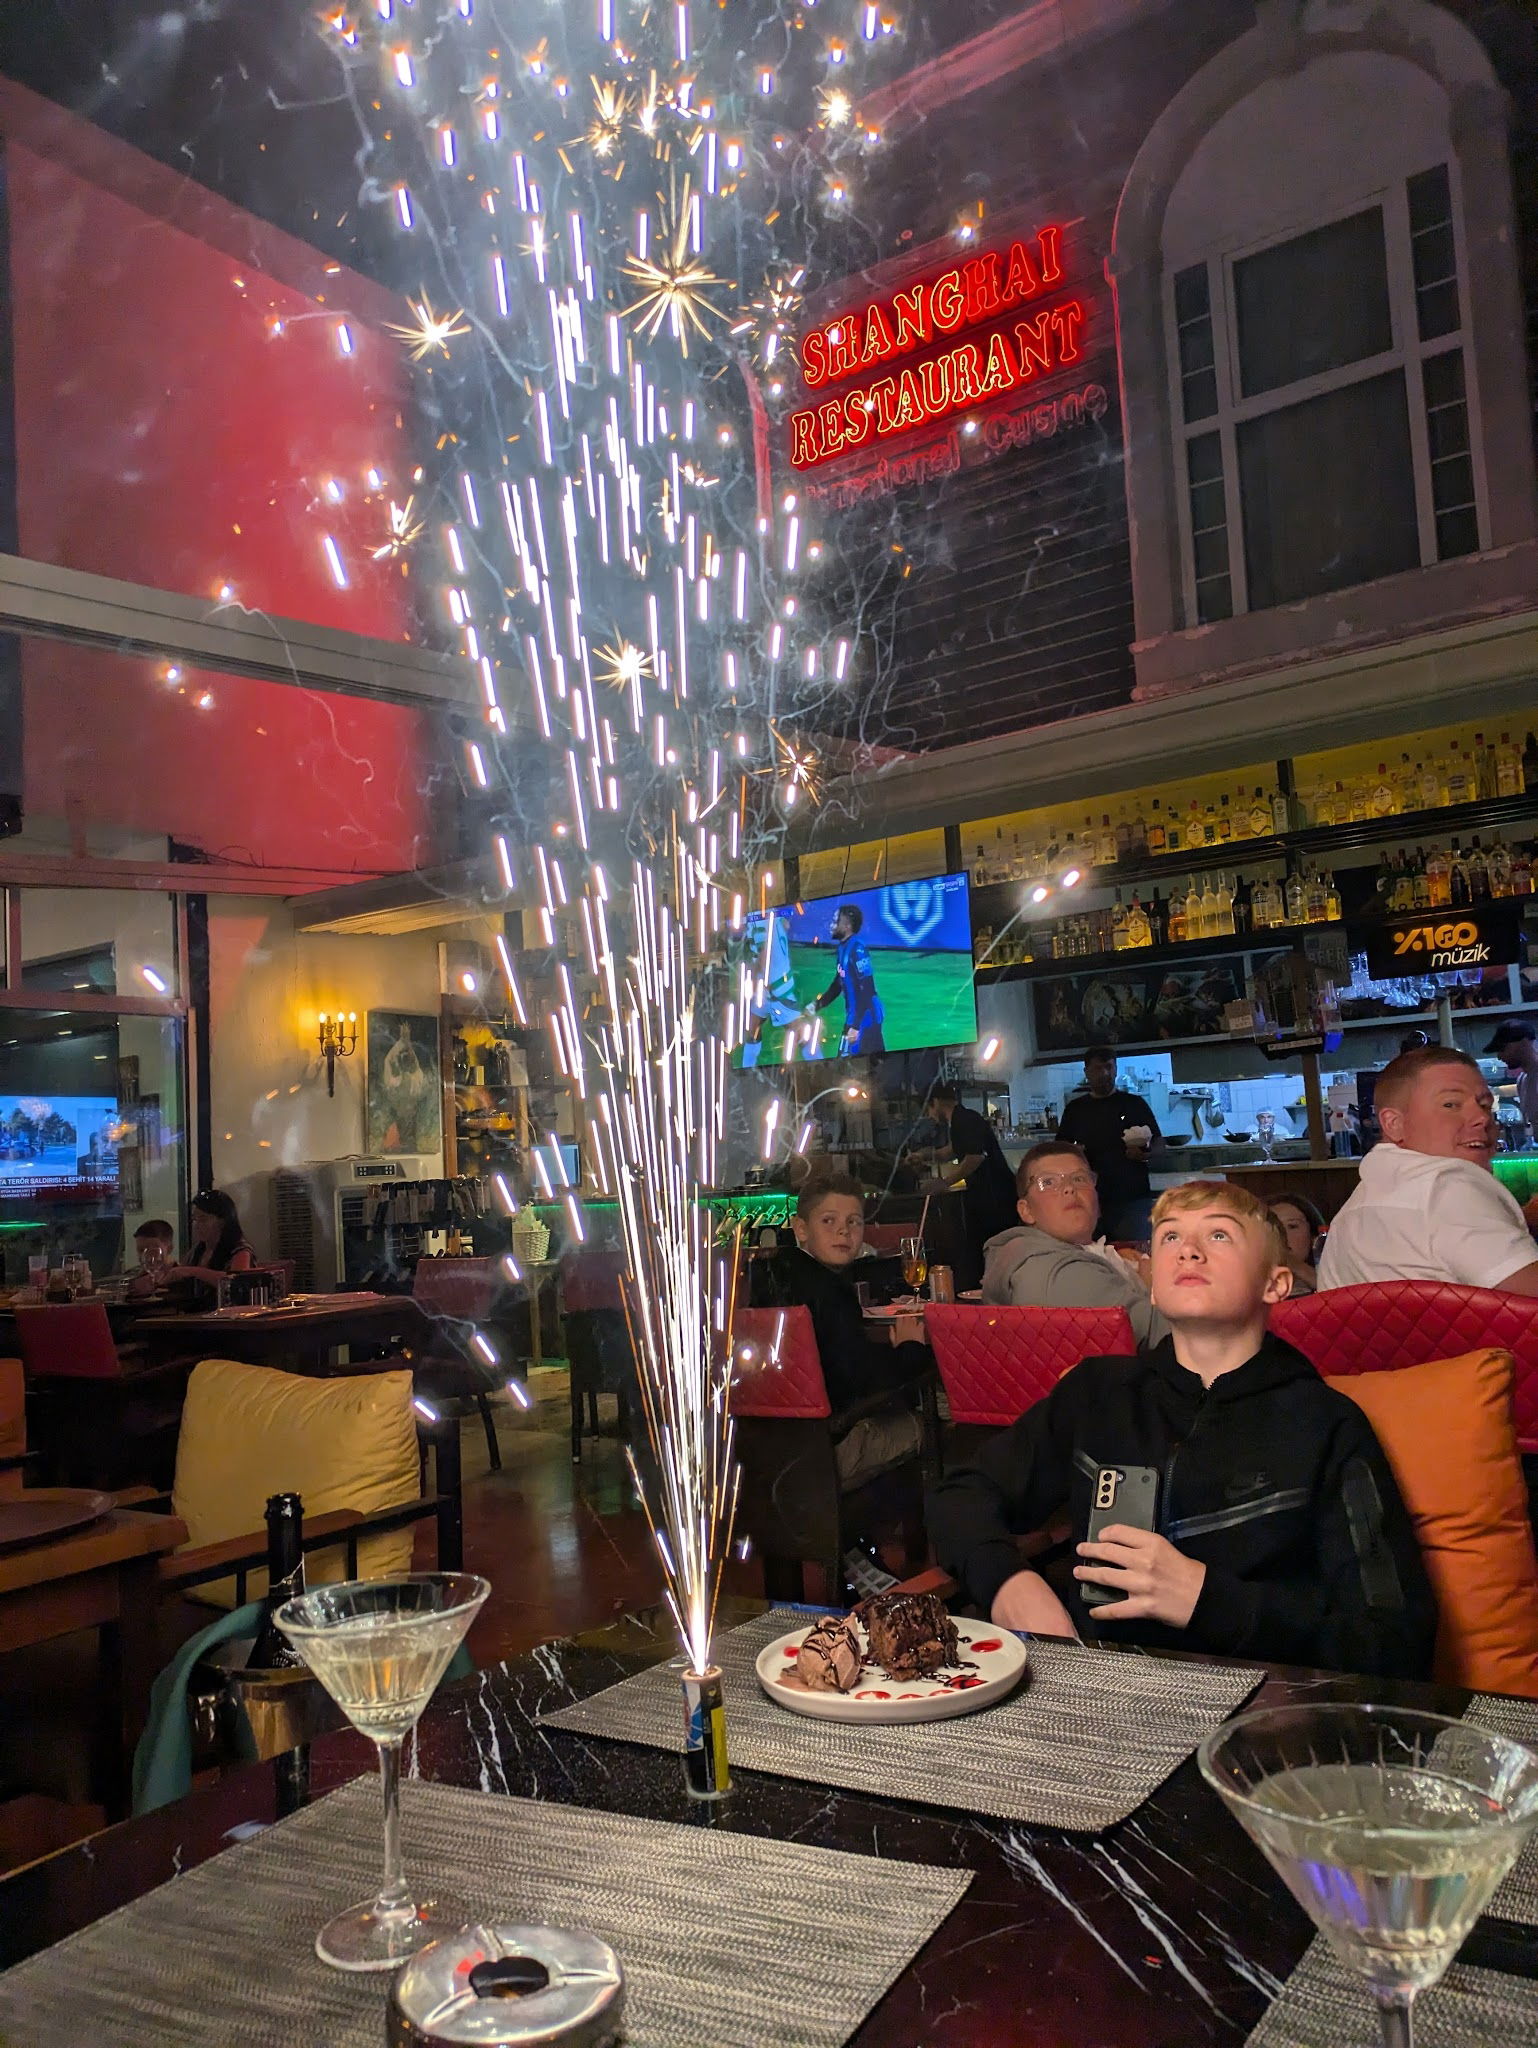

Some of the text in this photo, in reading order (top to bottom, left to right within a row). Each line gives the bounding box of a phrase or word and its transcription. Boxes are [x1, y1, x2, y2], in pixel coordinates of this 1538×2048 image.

[802, 227, 1061, 385] SHANGHAI
[791, 301, 1083, 465] RESTAURANT
[1431, 943, 1491, 967] müzik
[8, 1177, 31, 1185] TERÖR
[68, 1175, 86, 1184] ŞEHİT
[87, 1175, 94, 1183] 14
